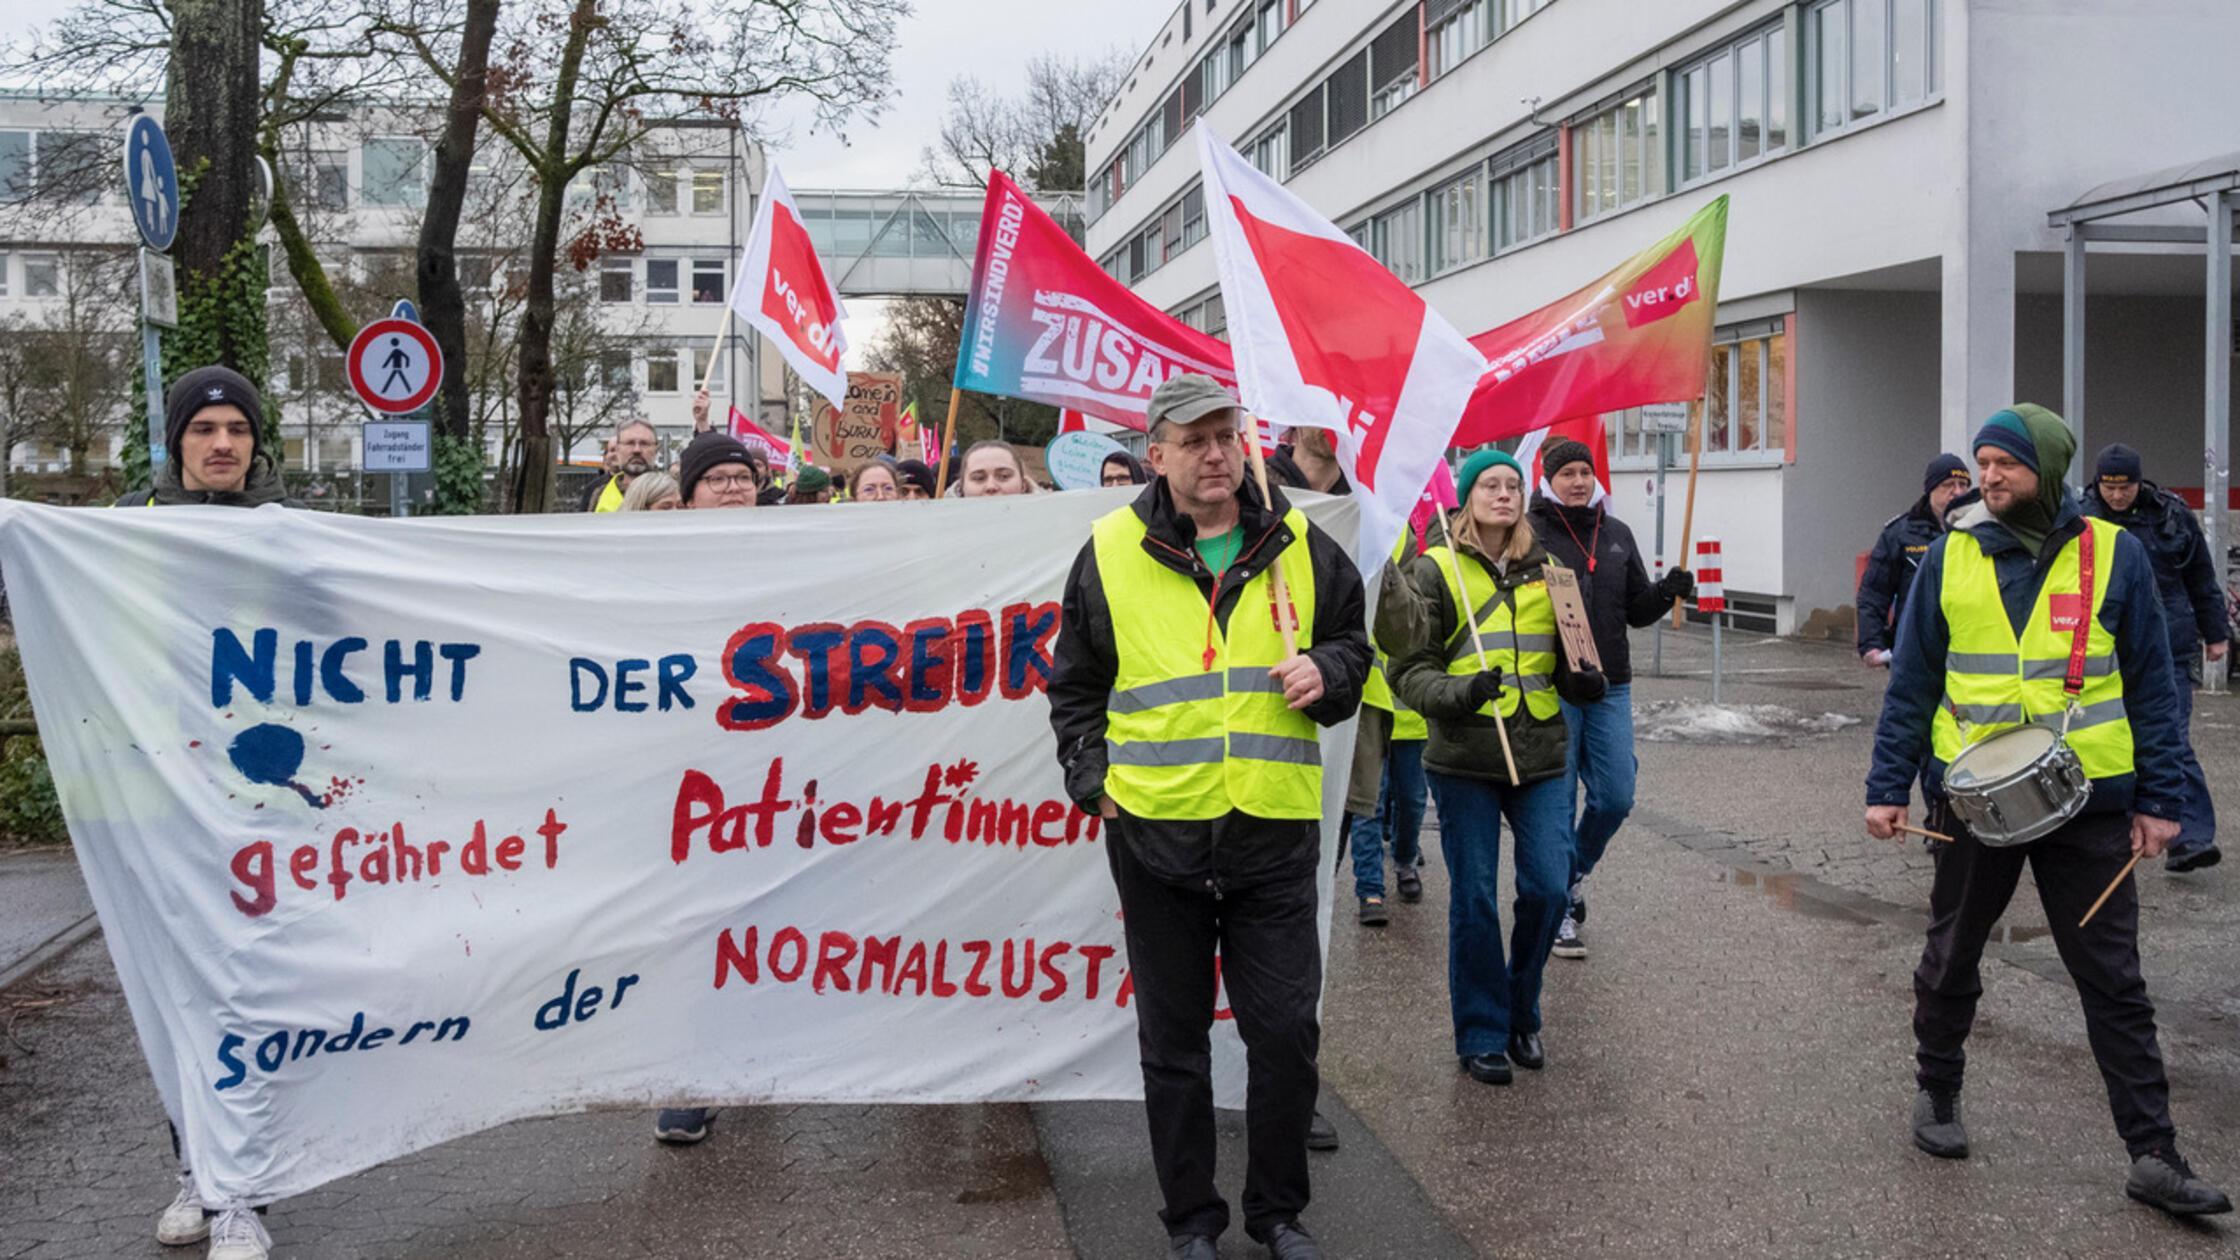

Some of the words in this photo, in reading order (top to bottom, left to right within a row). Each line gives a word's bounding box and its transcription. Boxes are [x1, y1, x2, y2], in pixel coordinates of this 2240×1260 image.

[1024, 307, 1184, 395] ZUSA
[367, 441, 425, 453] Fahrradständer
[383, 428, 409, 441] Zugang
[387, 453, 406, 464] frei
[211, 626, 481, 709] NICHT
[568, 653, 698, 712] DER
[715, 601, 1063, 731] STREIK
[229, 807, 568, 918] gefährdet
[534, 967, 640, 1031] der
